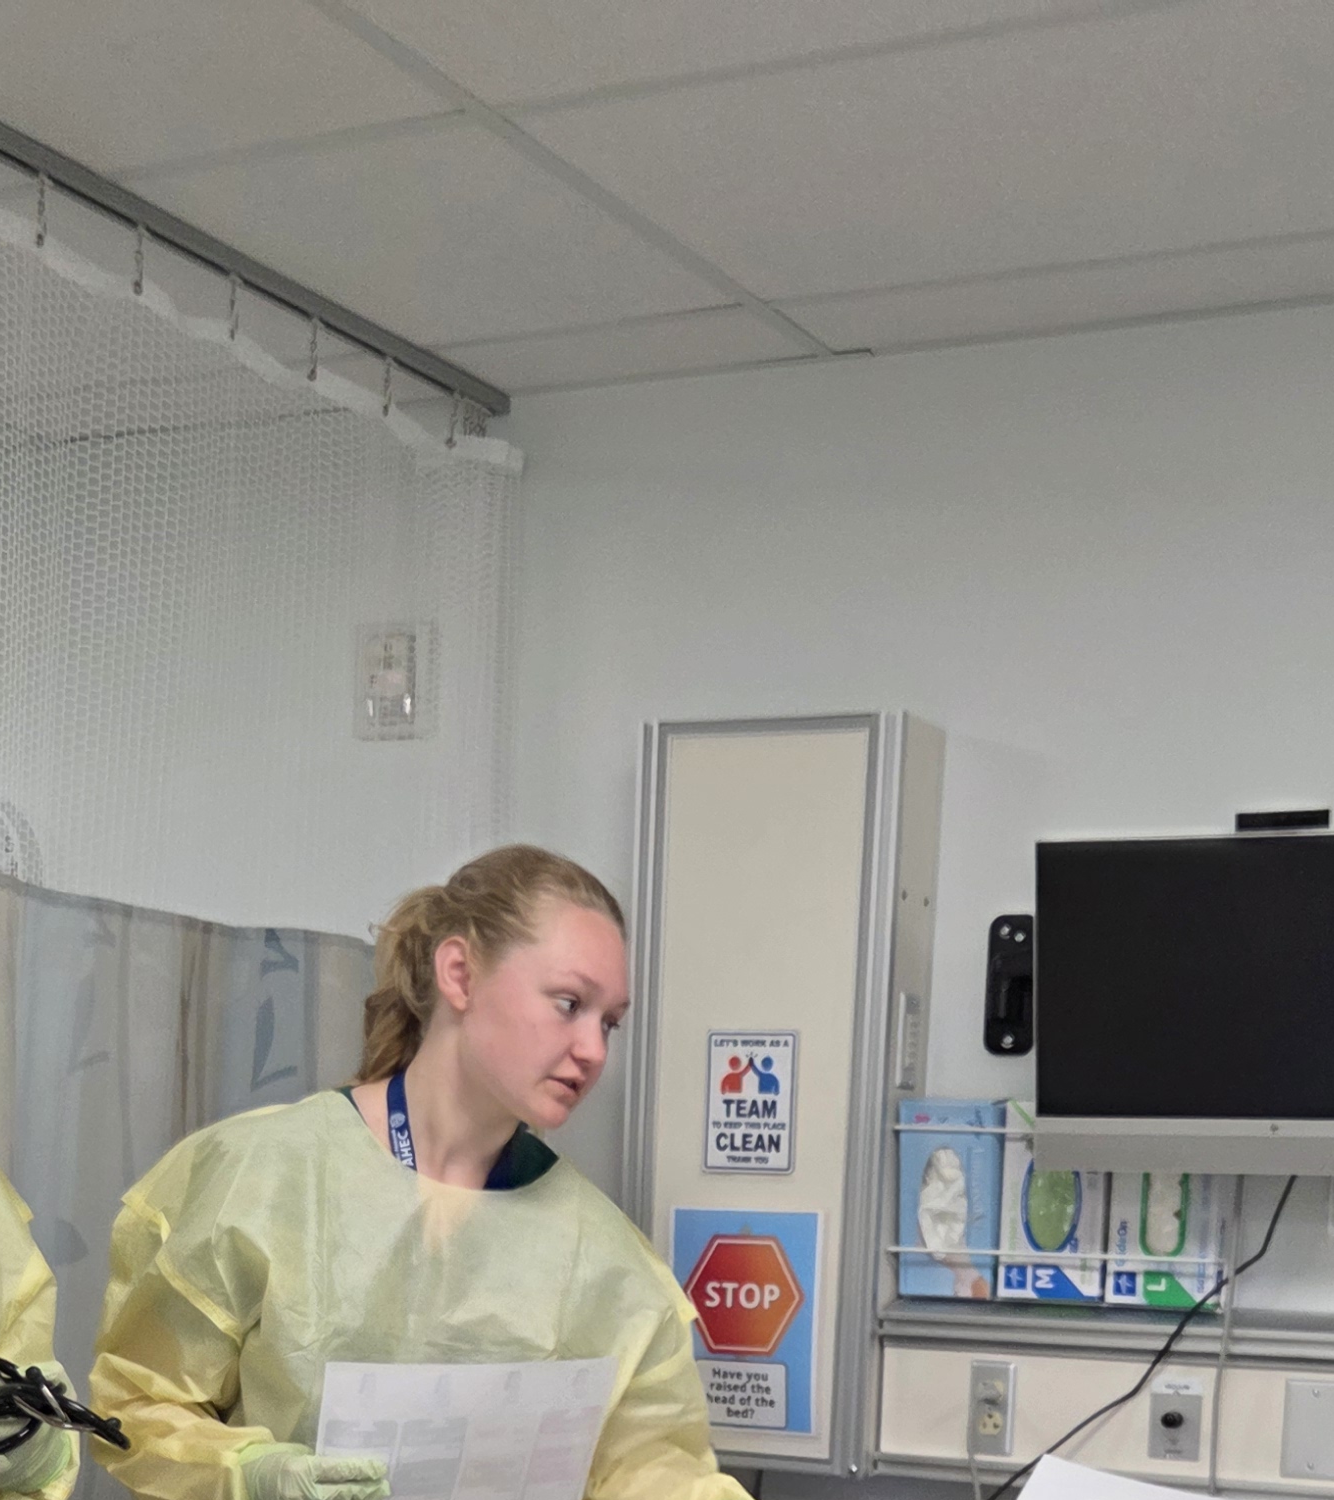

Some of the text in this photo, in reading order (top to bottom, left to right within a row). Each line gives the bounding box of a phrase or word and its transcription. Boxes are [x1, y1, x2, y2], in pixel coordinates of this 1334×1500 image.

[713, 1038, 790, 1048] LET'S WORK AS A
[722, 1098, 777, 1119] TEAM
[711, 1120, 722, 1130] TO
[763, 1121, 786, 1132] PLACE
[397, 1129, 414, 1167] AHEC
[715, 1132, 781, 1154] CLEAN
[726, 1155, 769, 1165] THANK YOU
[1034, 1268, 1057, 1289] M
[1146, 1277, 1166, 1291] L
[704, 1281, 781, 1311] STOP
[712, 1366, 769, 1384] Have you
[709, 1381, 772, 1395] raised the
[738, 1395, 752, 1406] of
[754, 1396, 776, 1409] the
[725, 1406, 756, 1420] bed?
